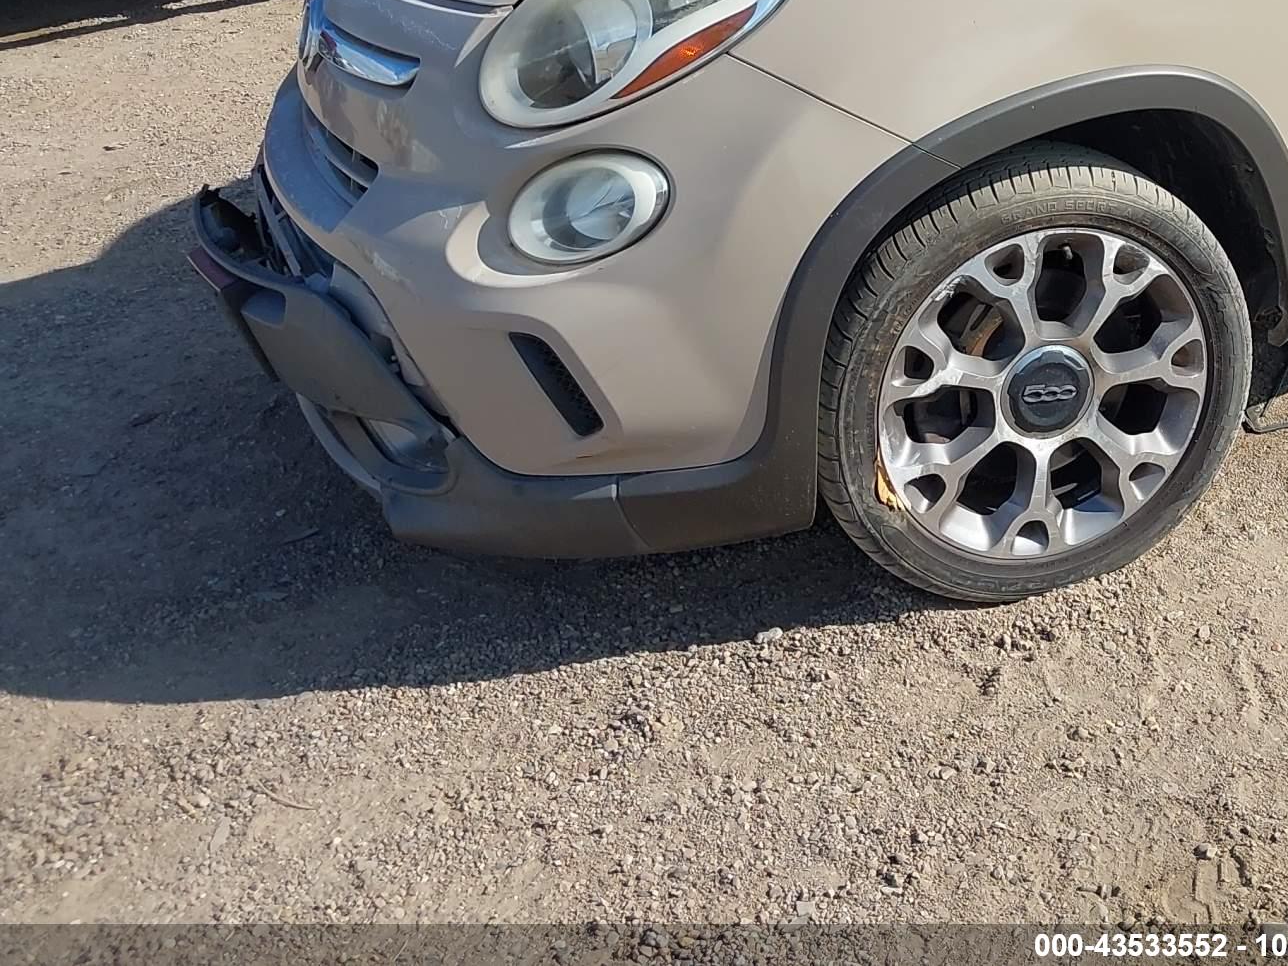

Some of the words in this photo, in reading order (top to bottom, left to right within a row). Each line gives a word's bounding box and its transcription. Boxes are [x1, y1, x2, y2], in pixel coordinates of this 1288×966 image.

[1001, 201, 1057, 225] GRAND
[1064, 199, 1119, 213] SPORT
[1022, 383, 1078, 404] 500
